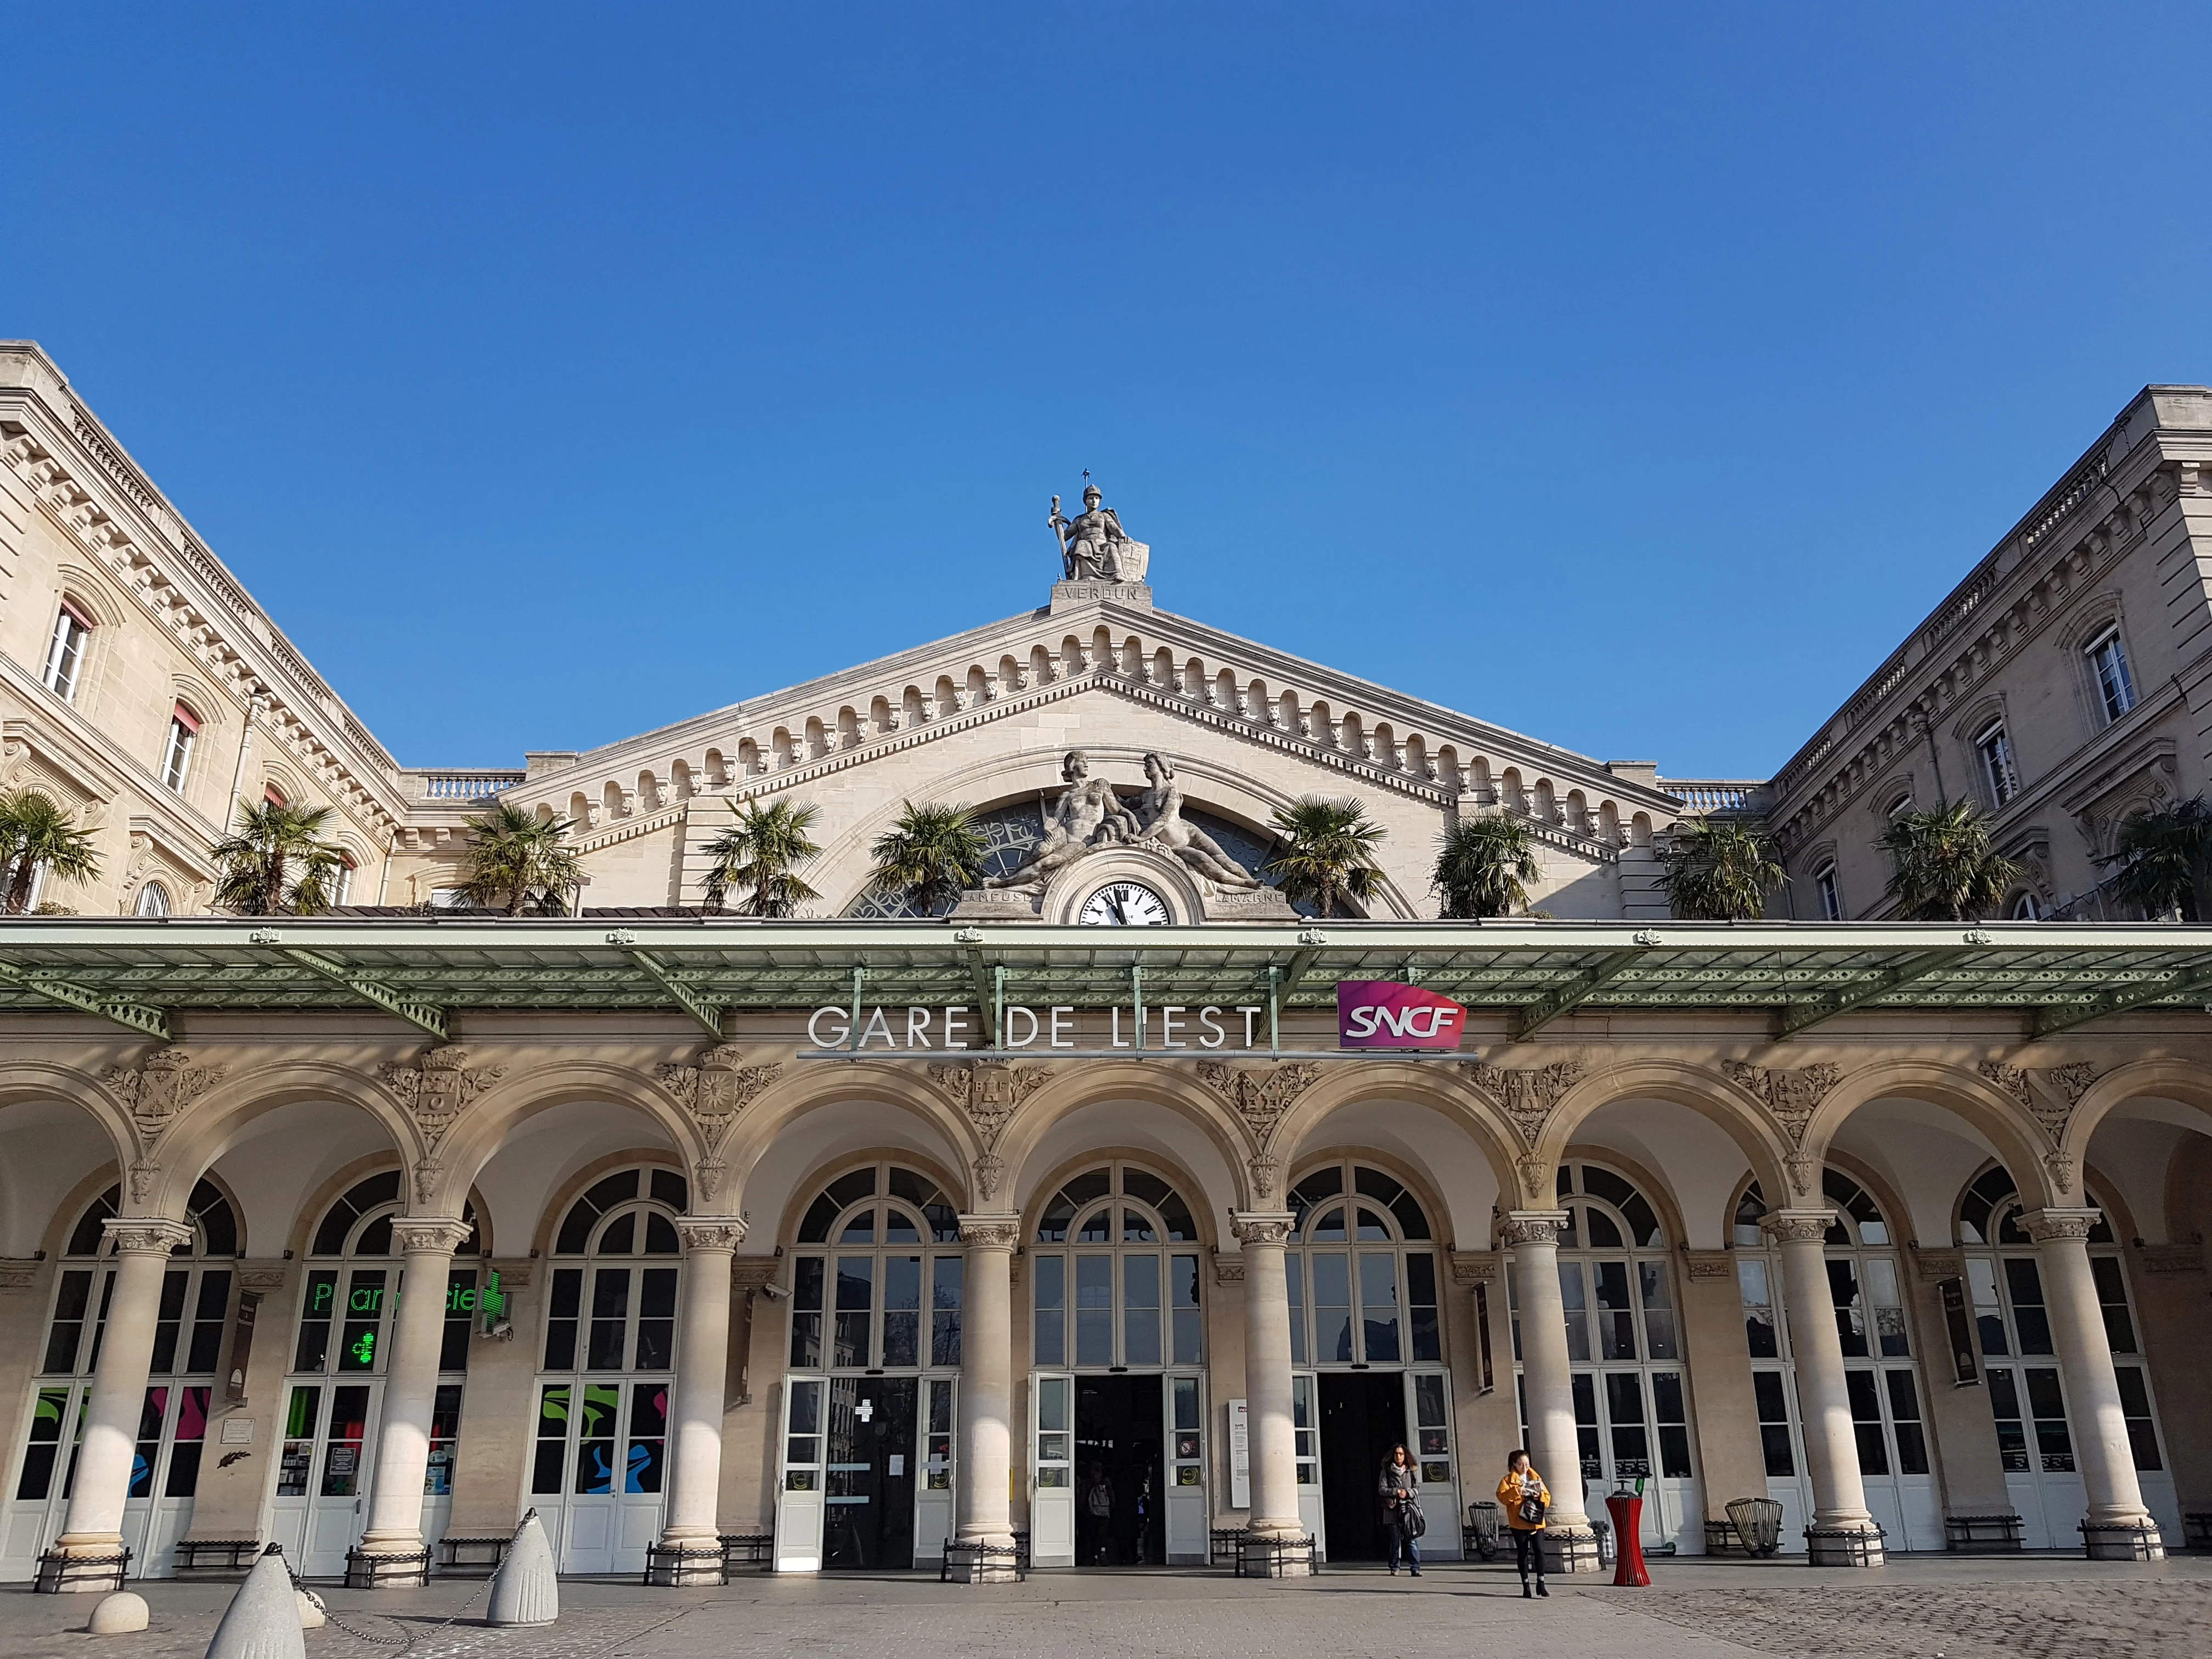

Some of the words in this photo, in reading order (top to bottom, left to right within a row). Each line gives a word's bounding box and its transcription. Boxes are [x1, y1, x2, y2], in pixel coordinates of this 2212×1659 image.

[1064, 587, 1138, 601] VERDUN
[962, 893, 975, 902] LA
[978, 893, 1032, 902] MEUSE
[1215, 893, 1229, 902] LA
[1231, 894, 1284, 902] MARNE
[808, 1006, 969, 1048] GARE
[1007, 1006, 1074, 1047] DE
[1112, 1006, 1262, 1048] L'EST
[1345, 1006, 1459, 1037] SNCF
[975, 1081, 983, 1092] B
[998, 1081, 1007, 1092] F
[314, 1283, 476, 1311] Parie
